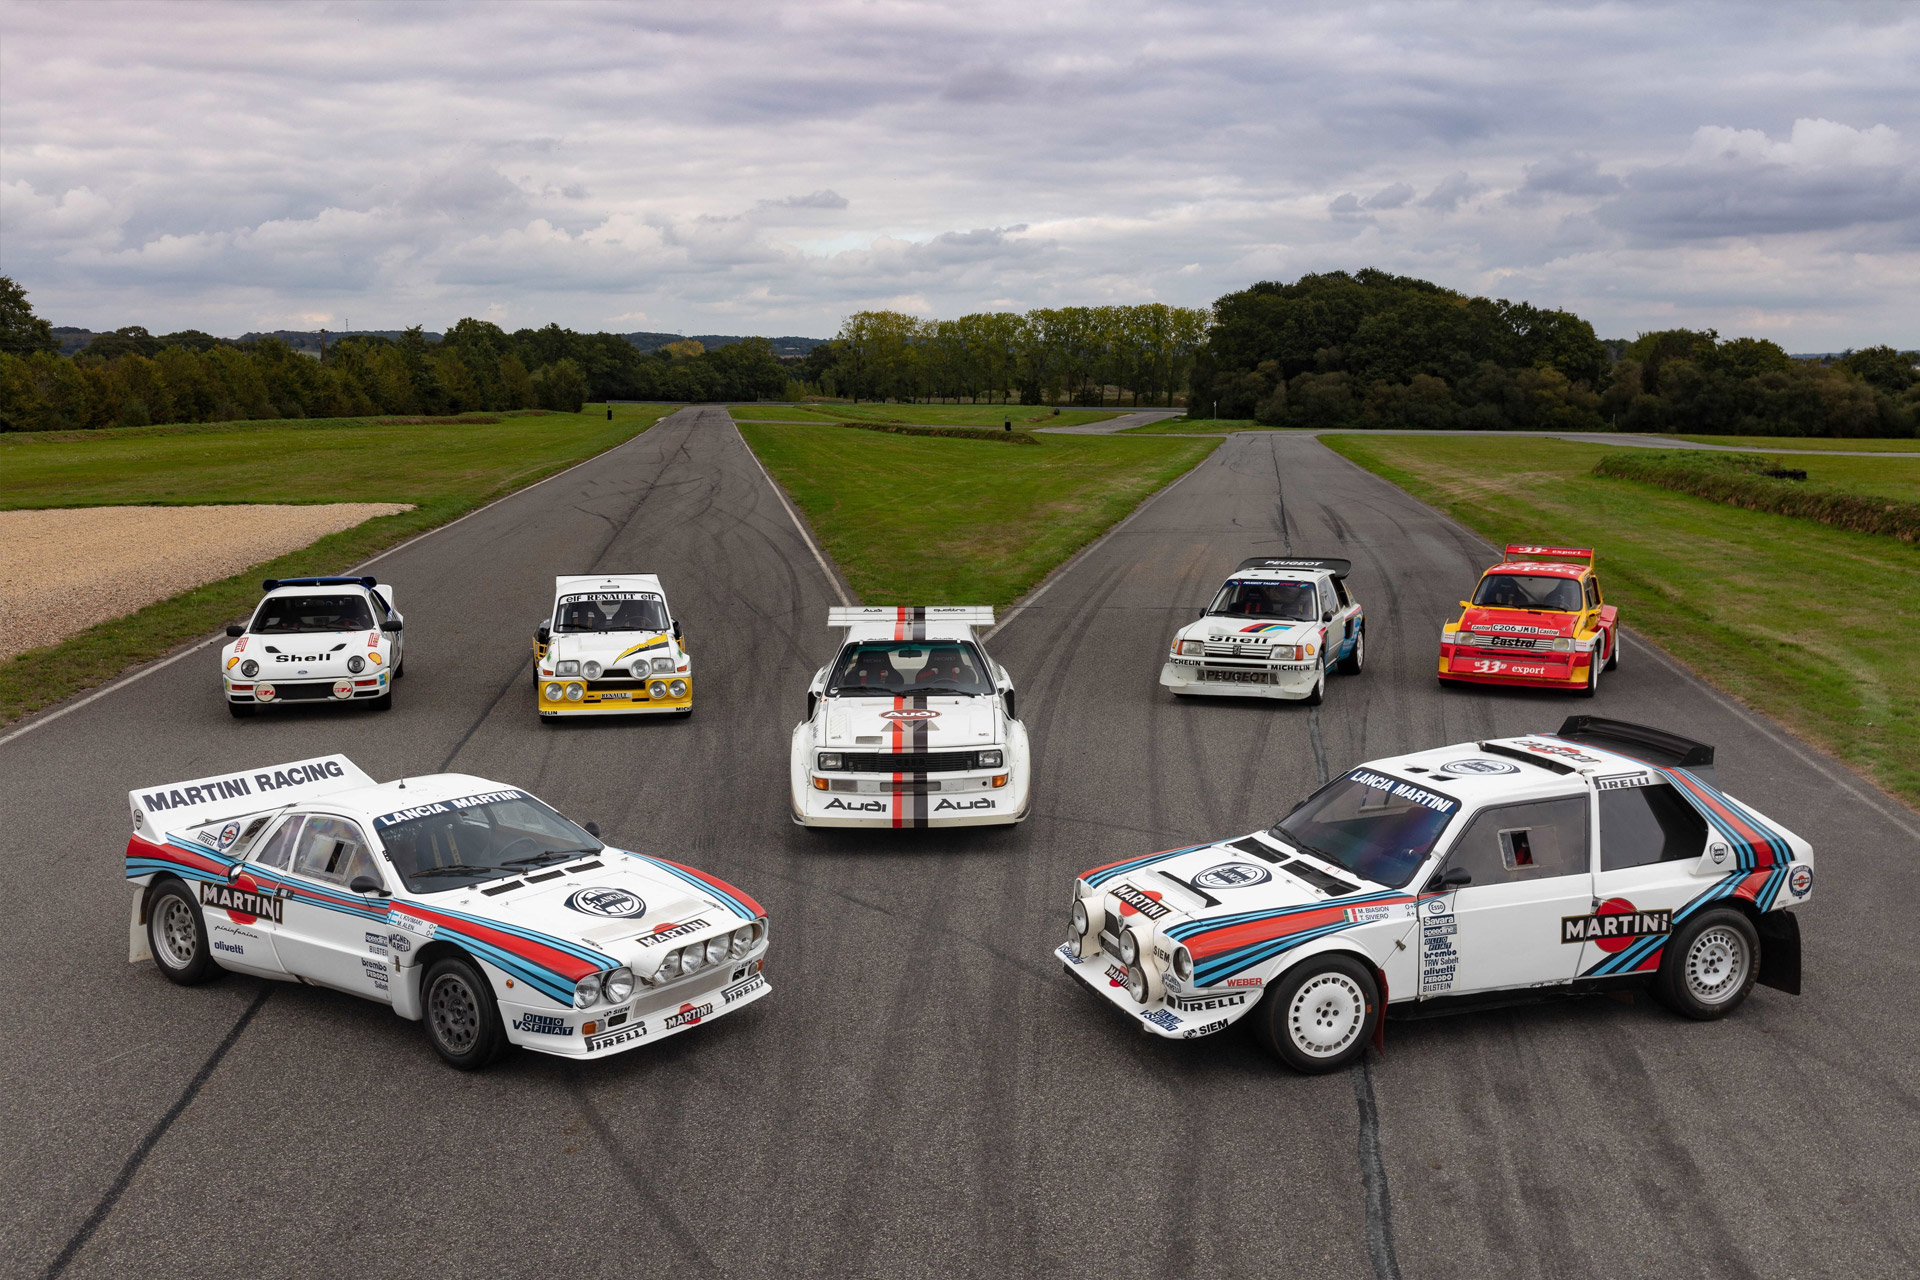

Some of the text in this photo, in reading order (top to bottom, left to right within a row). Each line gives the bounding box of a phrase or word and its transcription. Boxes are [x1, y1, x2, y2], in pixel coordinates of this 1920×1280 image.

[566, 593, 656, 603] elf RENAULT elf
[1493, 624, 1516, 632] C206
[1209, 635, 1268, 644] Shell
[1491, 636, 1537, 648] Castrol
[275, 653, 331, 662] Shell
[1512, 665, 1544, 674] export
[1206, 670, 1269, 684] PEUGEOT
[883, 710, 937, 718] Audi
[142, 760, 345, 813] MARTINI RACING
[1592, 771, 1649, 790] PIRELLI
[1350, 770, 1454, 813] LANCIA MARTINI
[380, 790, 522, 826] LANCIA MARTINI
[823, 797, 887, 813] Audi
[933, 797, 996, 812] Audi
[203, 884, 280, 919] MARTINI
[1113, 885, 1168, 919] MARTINI
[1430, 904, 1444, 912] Esso
[1365, 906, 1390, 914] BIASION
[1365, 913, 1389, 921] SIVIERO
[1424, 916, 1454, 926] Savara
[402, 922, 415, 931] ALEN
[1565, 912, 1669, 940] MARTINI
[638, 920, 710, 947] MARTINI
[214, 941, 244, 955] olivetti
[1153, 945, 1170, 963] SIEM
[1424, 949, 1457, 959] brembo
[361, 958, 387, 972] brembo
[1424, 956, 1459, 967] TRW Sabelt
[367, 970, 388, 982] FERODO
[1424, 965, 1456, 976] olivetti
[1106, 965, 1130, 990] MARTI
[1227, 977, 1263, 987] WEBER
[1425, 974, 1453, 984] FERODO
[1423, 983, 1452, 993] BILSTEIN
[1175, 991, 1246, 1012] PIRELLI
[613, 1006, 631, 1015] SIEM
[667, 1003, 713, 1029] MARTINI
[524, 1013, 563, 1026] OLIO
[512, 1019, 574, 1036] VS FIAT
[1199, 1018, 1229, 1035] SIEM
[584, 1021, 648, 1053] PIRELLI
